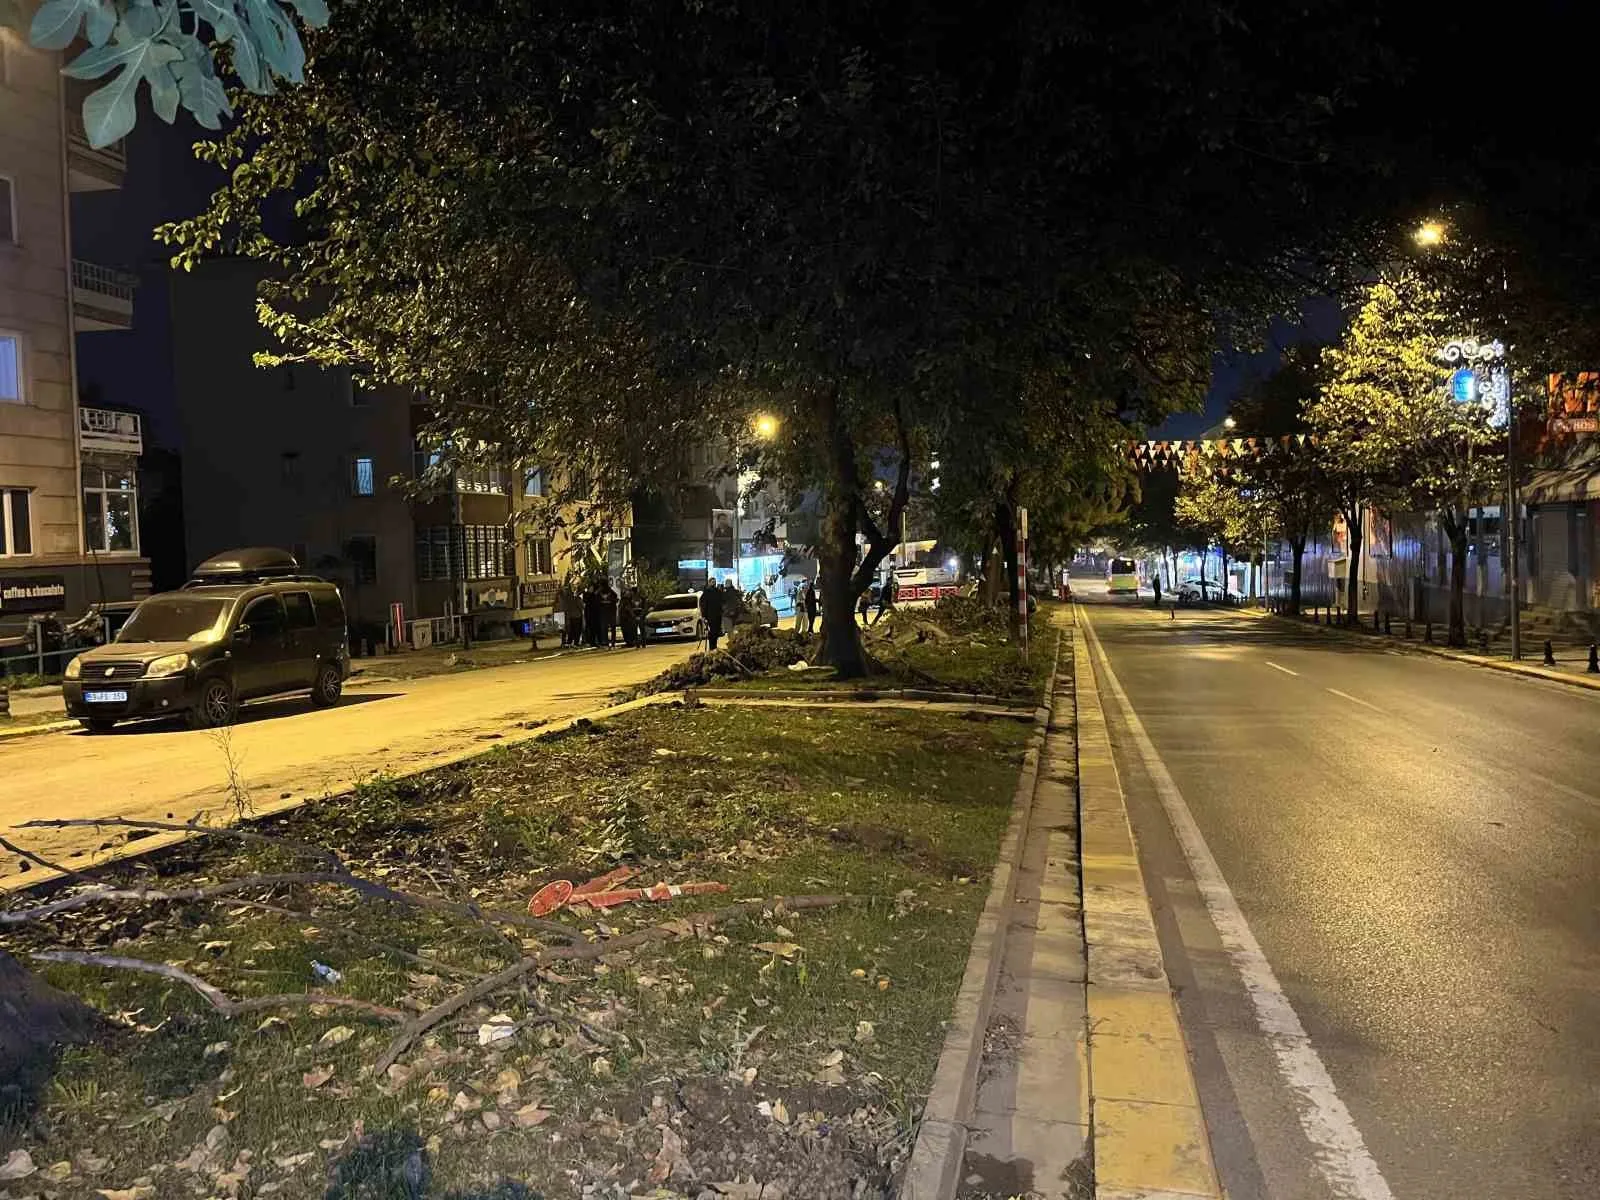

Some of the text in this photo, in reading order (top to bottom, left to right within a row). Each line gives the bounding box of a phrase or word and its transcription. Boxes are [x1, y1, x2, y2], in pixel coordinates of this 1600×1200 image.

[4, 584, 64, 599] coffee & chocolate
